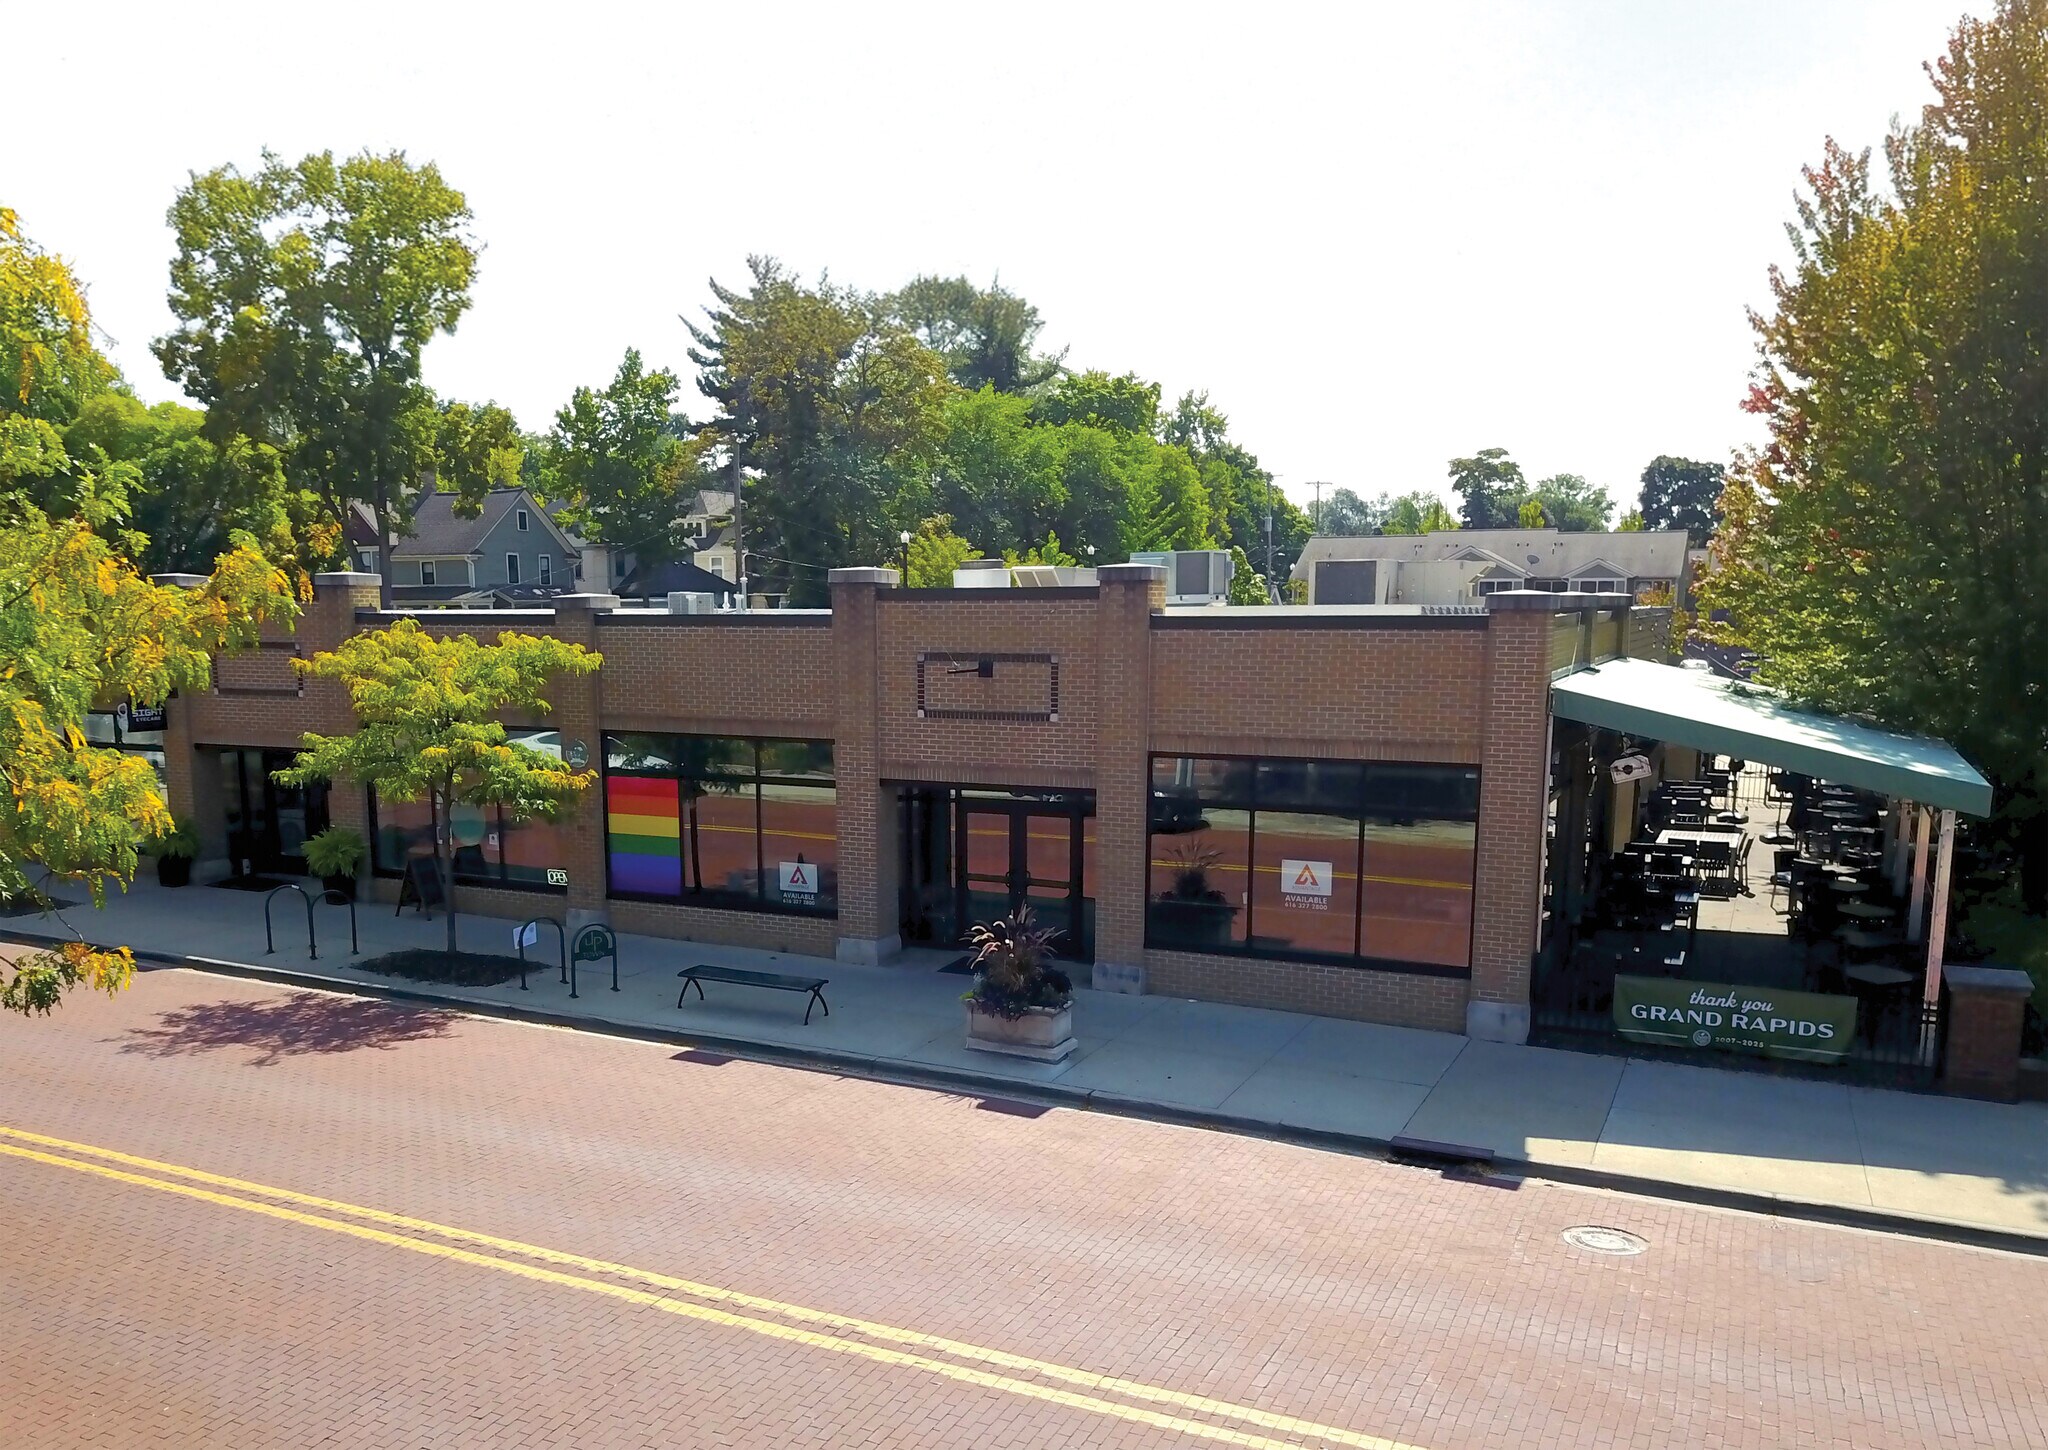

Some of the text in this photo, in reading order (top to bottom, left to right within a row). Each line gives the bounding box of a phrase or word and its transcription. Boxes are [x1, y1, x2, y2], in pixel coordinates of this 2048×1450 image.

[783, 892, 815, 901] AVAILABLE
[1285, 895, 1328, 904] AVAILABLE
[1690, 988, 1774, 1013] thank you
[1631, 1004, 1834, 1038] GRAND RAPIDS
